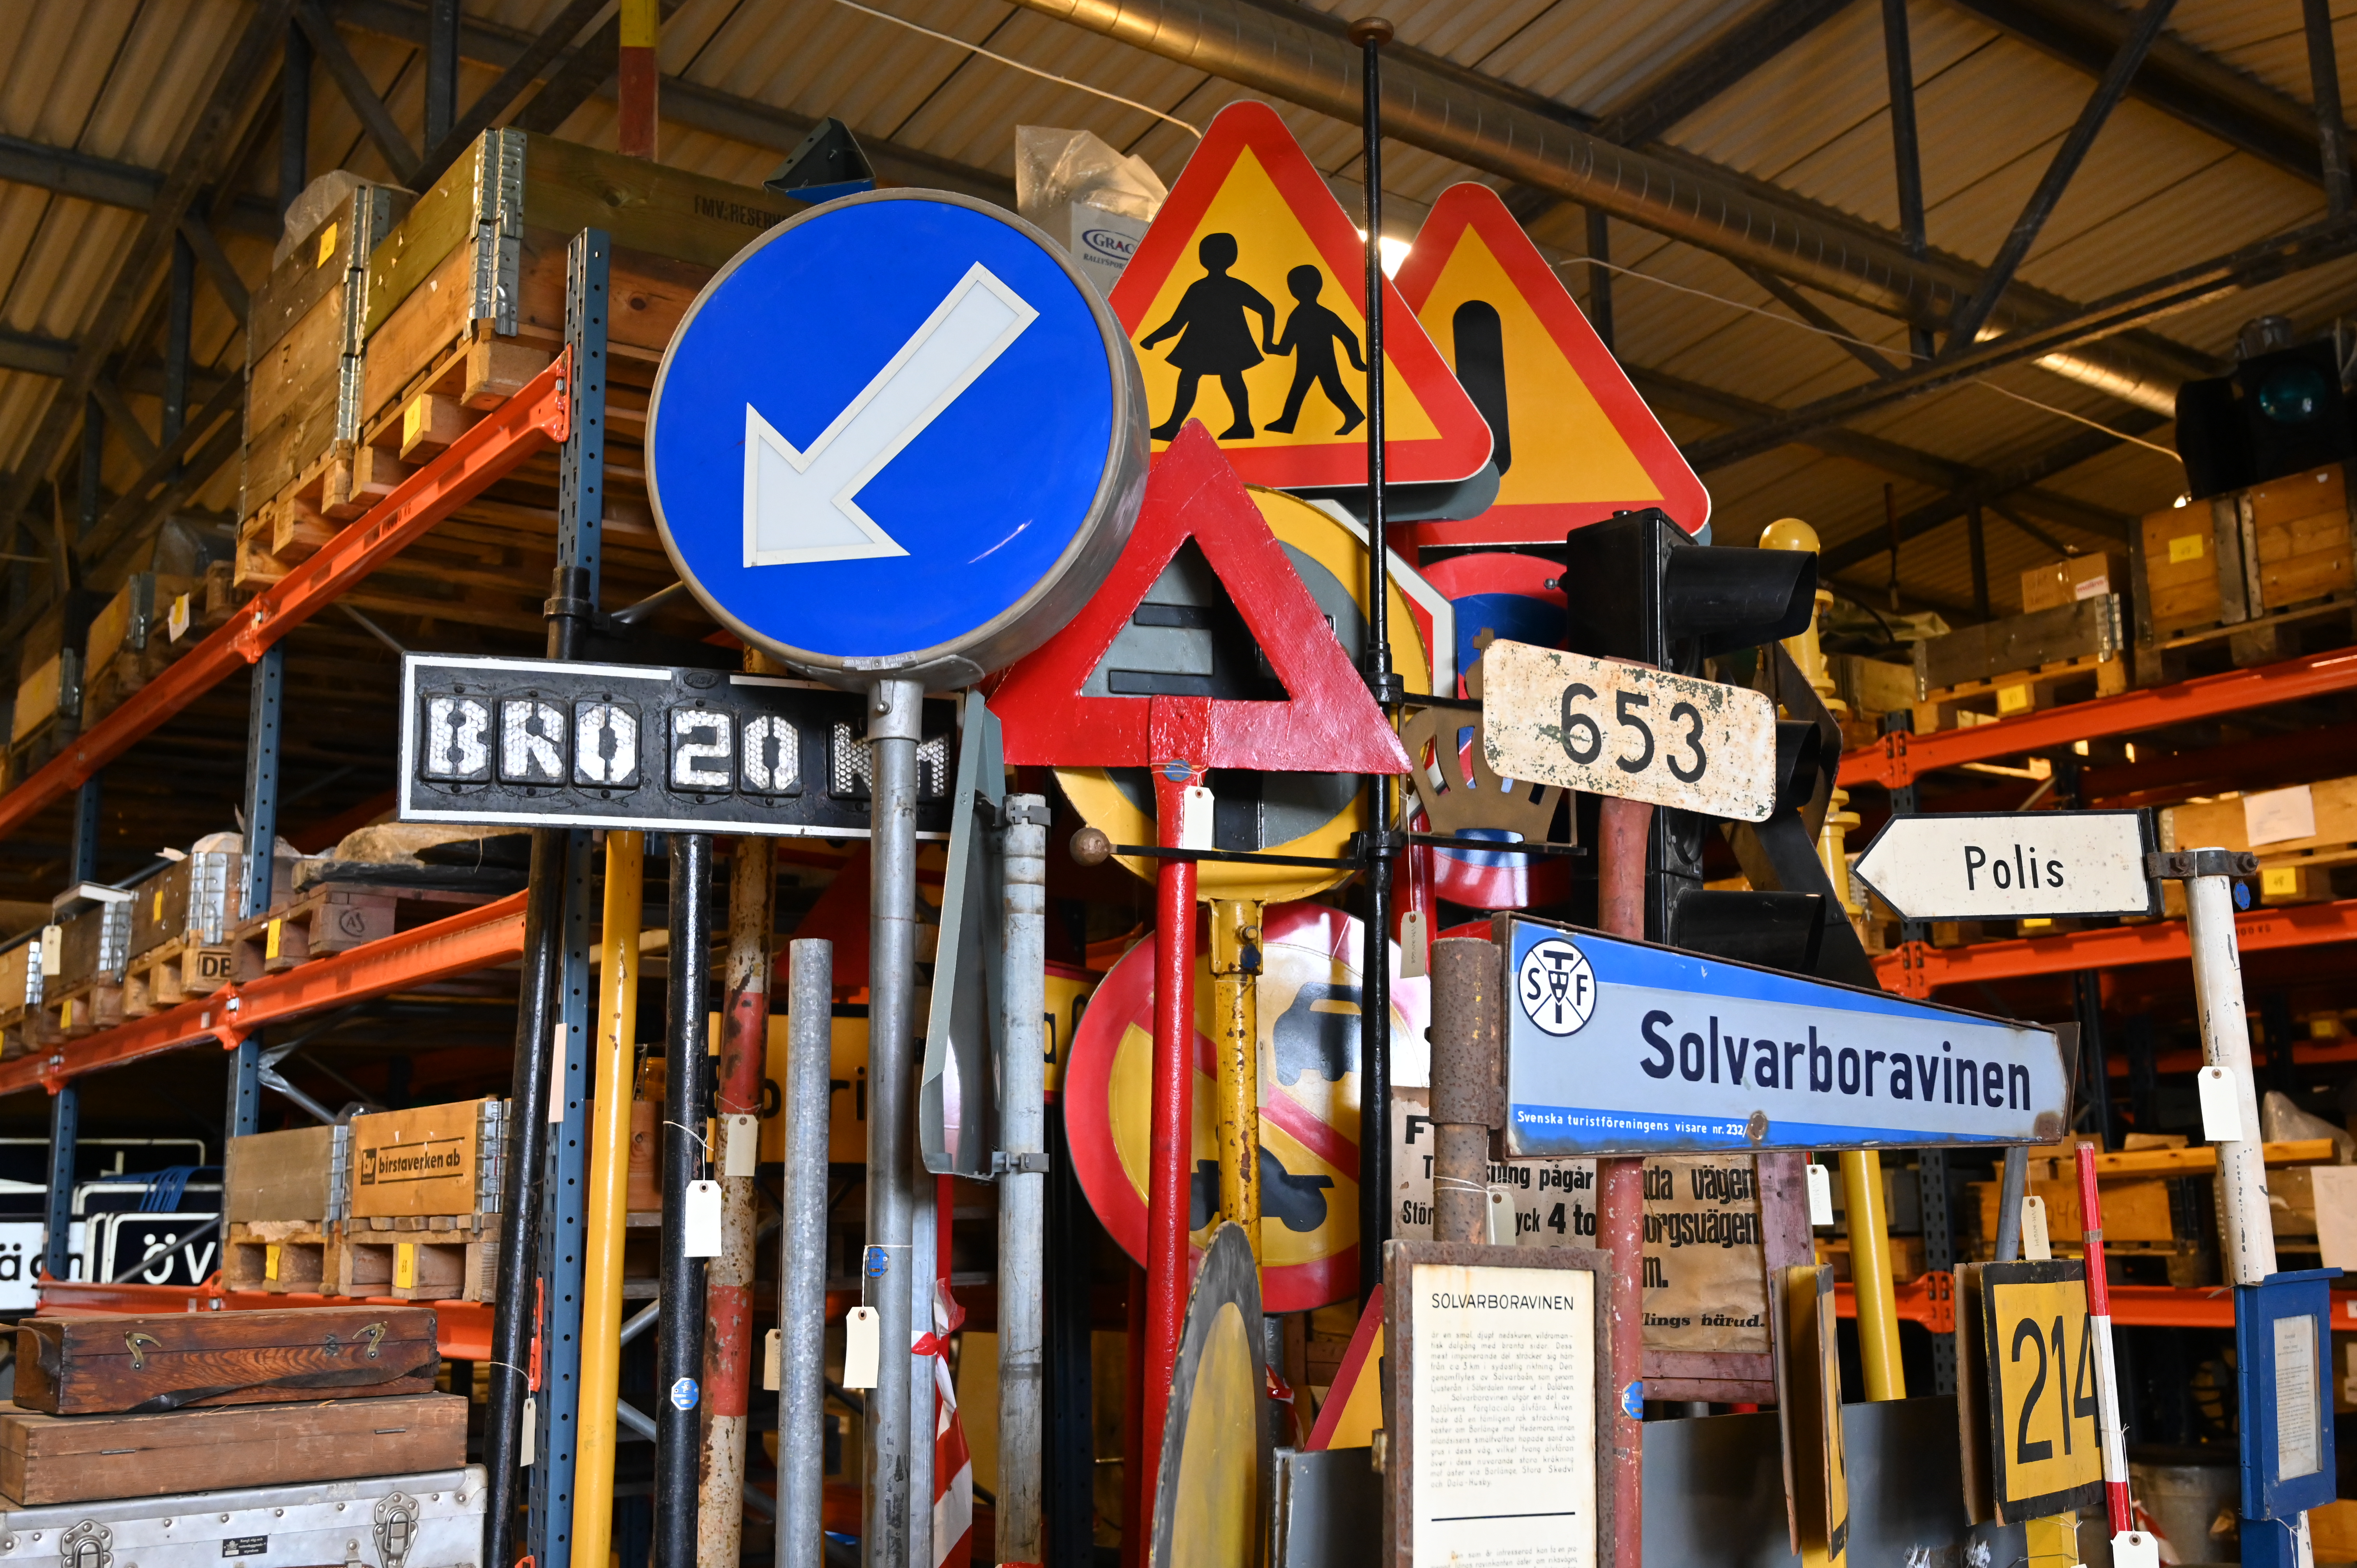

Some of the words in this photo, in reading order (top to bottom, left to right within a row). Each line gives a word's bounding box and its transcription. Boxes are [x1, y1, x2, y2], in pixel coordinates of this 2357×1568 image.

[1084, 253, 1124, 269] RALLYSPOR
[1093, 233, 1135, 254] GRAC
[429, 697, 636, 782] BRO
[675, 711, 799, 791] 20
[1560, 683, 1707, 783] 653
[1965, 844, 2064, 891] Polis
[1640, 1009, 2031, 1111] Solvarboravinen
[1517, 1111, 1563, 1124] Svenska
[1567, 1114, 1669, 1133] turistföreningens
[1675, 1121, 1707, 1134] visare
[1712, 1126, 1724, 1134] nr.
[379, 1151, 443, 1174] birstaverken
[446, 1148, 460, 1167] ab
[1539, 1164, 1594, 1193] pågår
[1691, 1165, 1756, 1204] vägen
[1403, 1200, 1434, 1225] Stör
[1548, 1202, 1566, 1234] 4
[1643, 1209, 1759, 1248] orgsvägen
[142, 1233, 217, 1285] öv
[1432, 1292, 1574, 1310] SOLVARBORAVINEN
